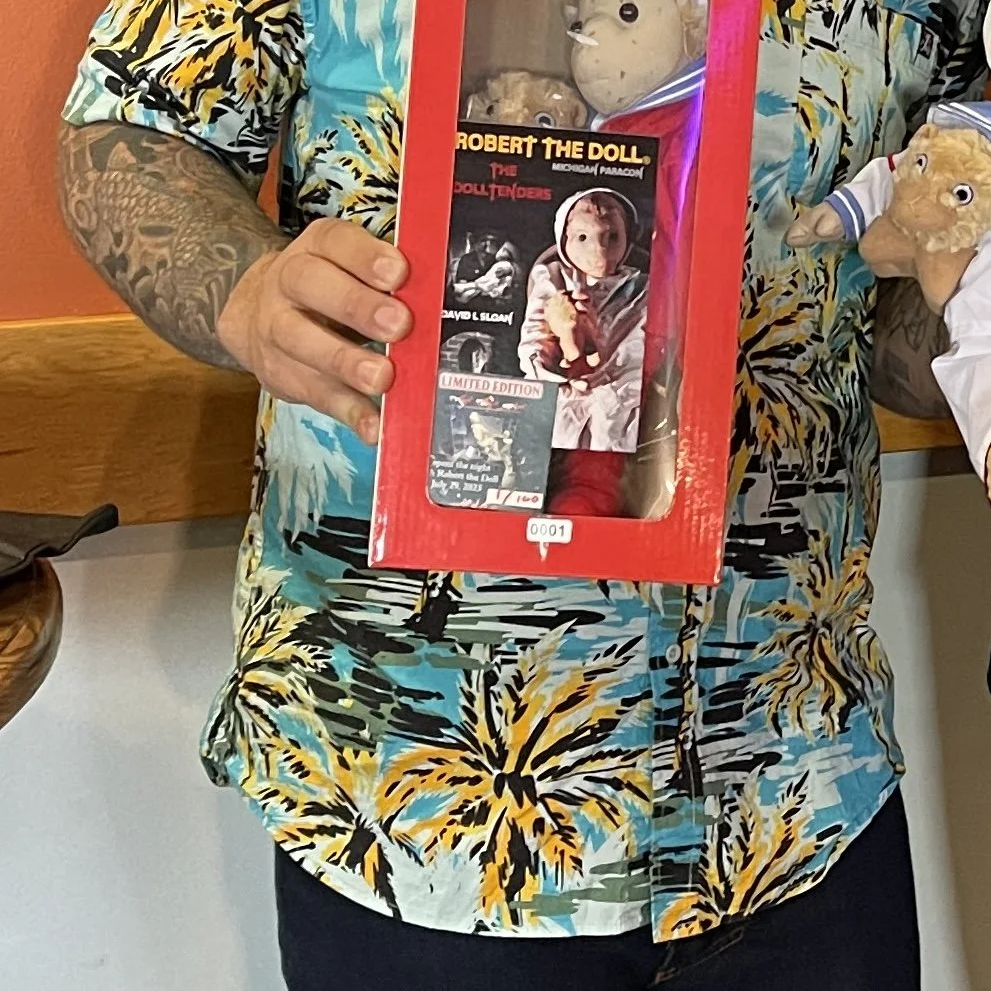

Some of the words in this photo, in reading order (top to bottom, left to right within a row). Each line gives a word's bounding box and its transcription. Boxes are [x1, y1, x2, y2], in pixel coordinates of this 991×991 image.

[455, 131, 538, 159] ROBERT
[541, 136, 584, 160] THE
[489, 161, 518, 179] THE
[551, 162, 600, 177] MICHIGAN
[600, 166, 645, 180] PARACON
[441, 309, 472, 321] DAVID
[479, 311, 515, 326] SLOAN
[441, 375, 490, 390] LIMITED
[493, 381, 540, 396] EDITION
[529, 522, 565, 538] 0001
